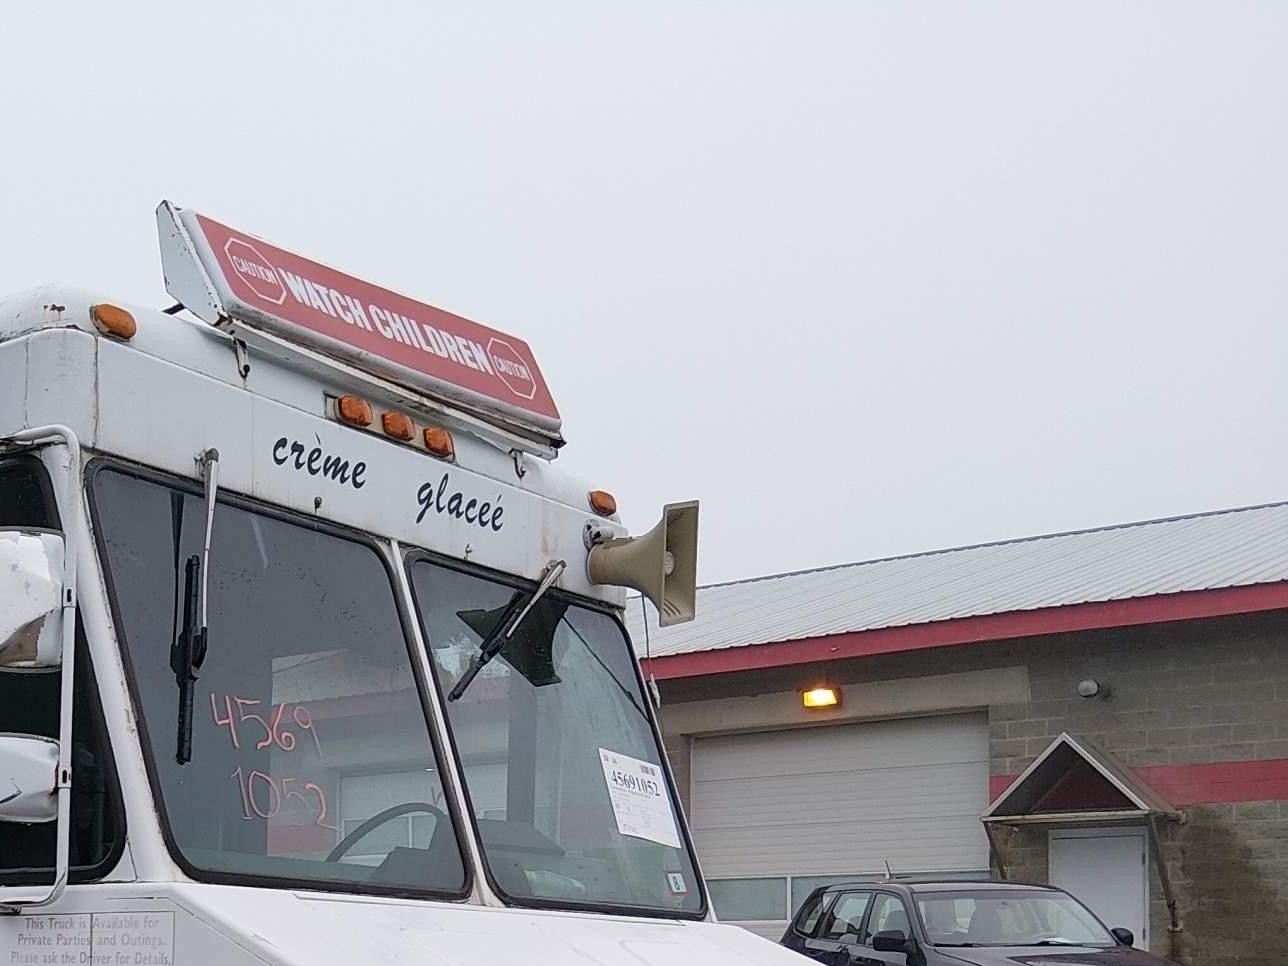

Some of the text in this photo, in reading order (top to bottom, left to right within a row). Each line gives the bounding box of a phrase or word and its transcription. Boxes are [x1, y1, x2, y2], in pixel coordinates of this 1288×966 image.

[232, 255, 279, 286] CAUTION
[278, 267, 495, 375] WATCH CHILDREN
[493, 353, 531, 381] CAUTION
[272, 432, 367, 489] crème
[210, 693, 323, 757] 4569
[611, 770, 661, 797] 45691052
[230, 765, 342, 832] 1052
[672, 875, 681, 891] 8
[25, 916, 160, 929] This Truck is Available for
[17, 934, 166, 949] Private Parties and Outings.
[11, 952, 171, 966] Please ask the Driver for Details,
